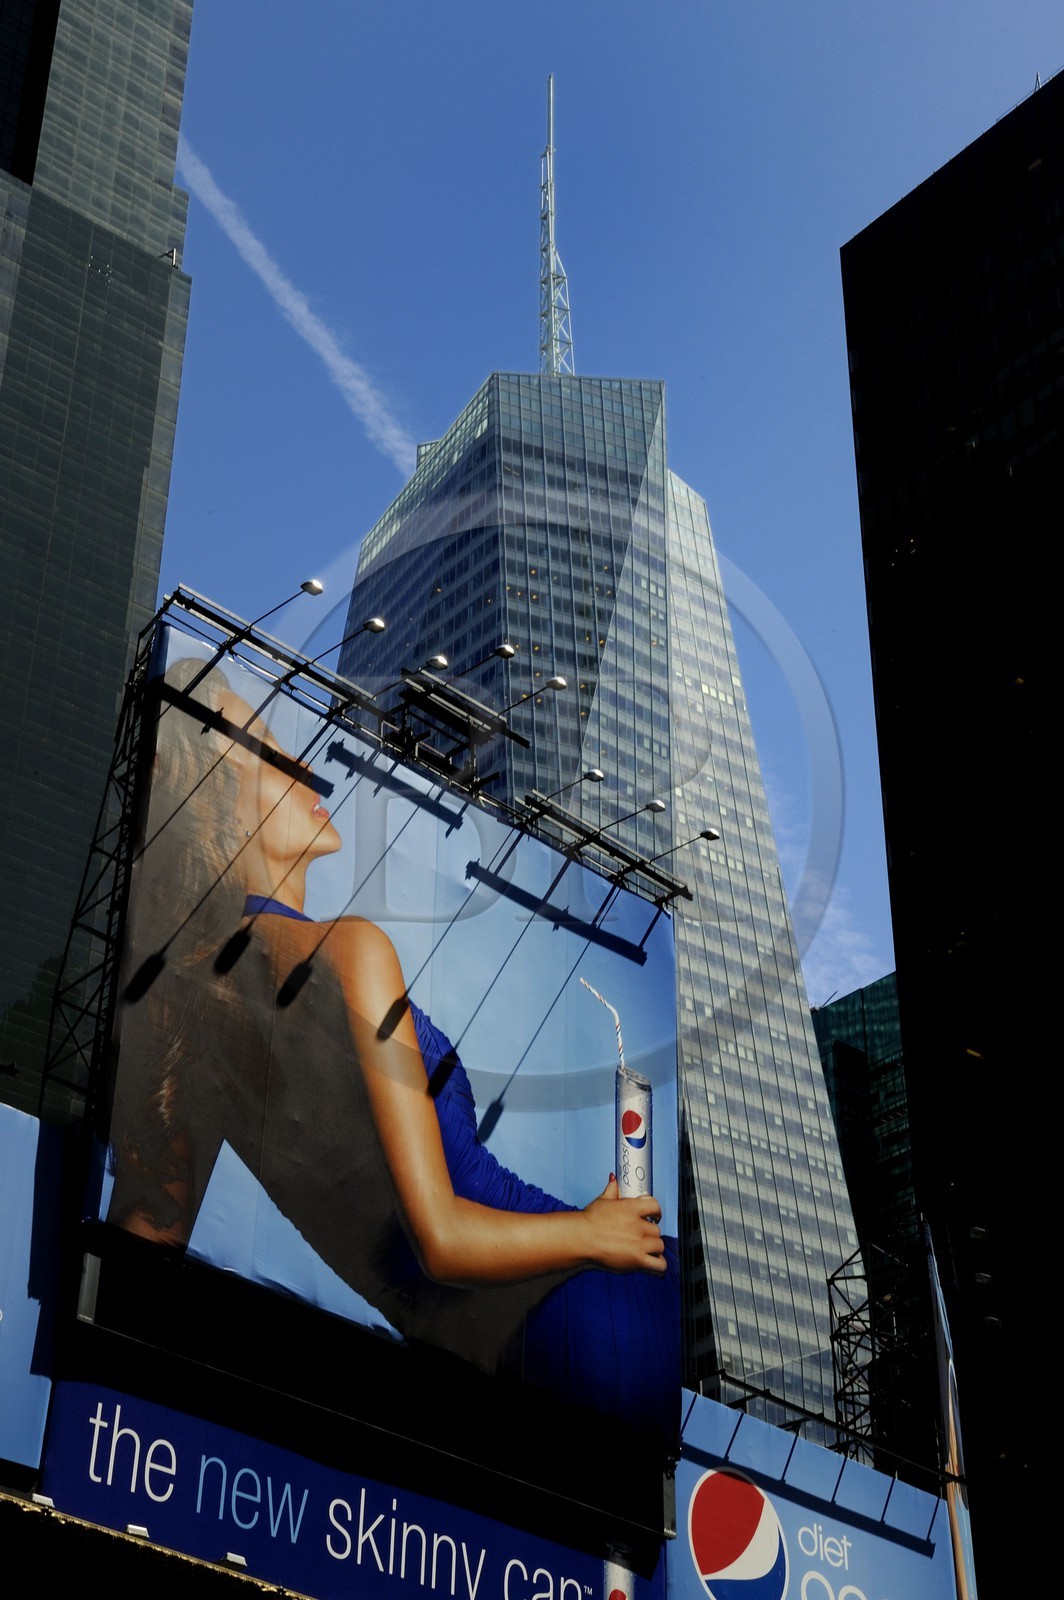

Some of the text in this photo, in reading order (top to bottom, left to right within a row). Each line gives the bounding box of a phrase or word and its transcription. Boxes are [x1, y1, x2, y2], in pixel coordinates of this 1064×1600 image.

[89, 1402, 177, 1502] the
[195, 1455, 309, 1544] new
[326, 1488, 486, 1600] skinny
[798, 1523, 852, 1570] diet
